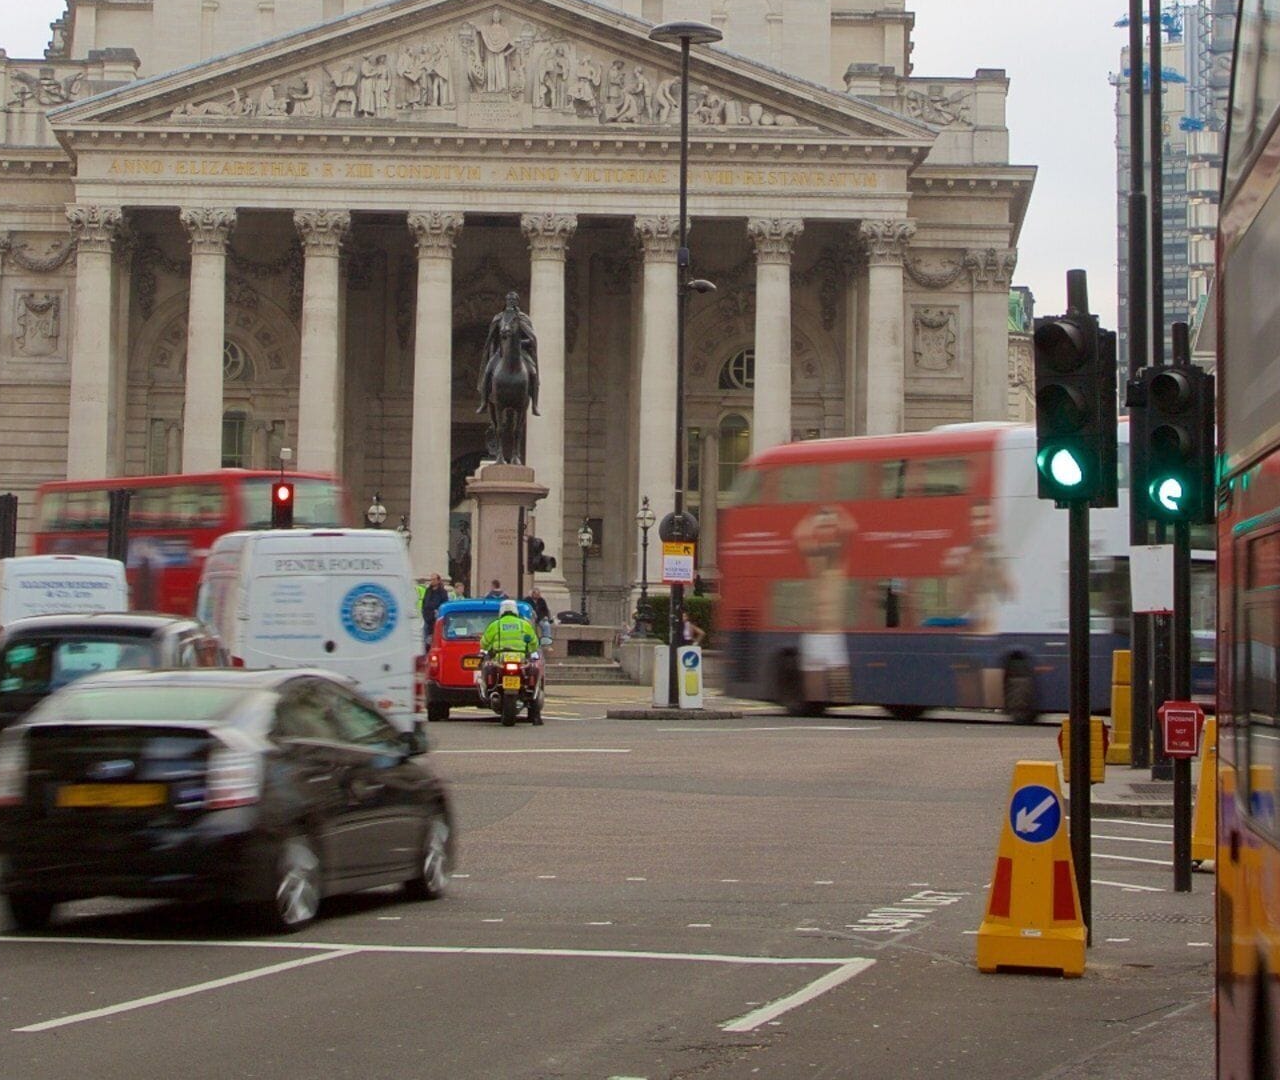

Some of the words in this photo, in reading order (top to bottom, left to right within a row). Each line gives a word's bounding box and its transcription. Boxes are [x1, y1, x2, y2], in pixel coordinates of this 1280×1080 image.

[108, 159, 164, 174] ANNO
[175, 160, 309, 177] ELIZABETHAE
[384, 164, 481, 180] CONDITVM
[505, 166, 560, 182] ANNO
[571, 167, 668, 184] VICTORIAE
[743, 170, 877, 188] RESTAVRATVM
[275, 559, 326, 571] PENTA
[328, 558, 384, 571] FOODS
